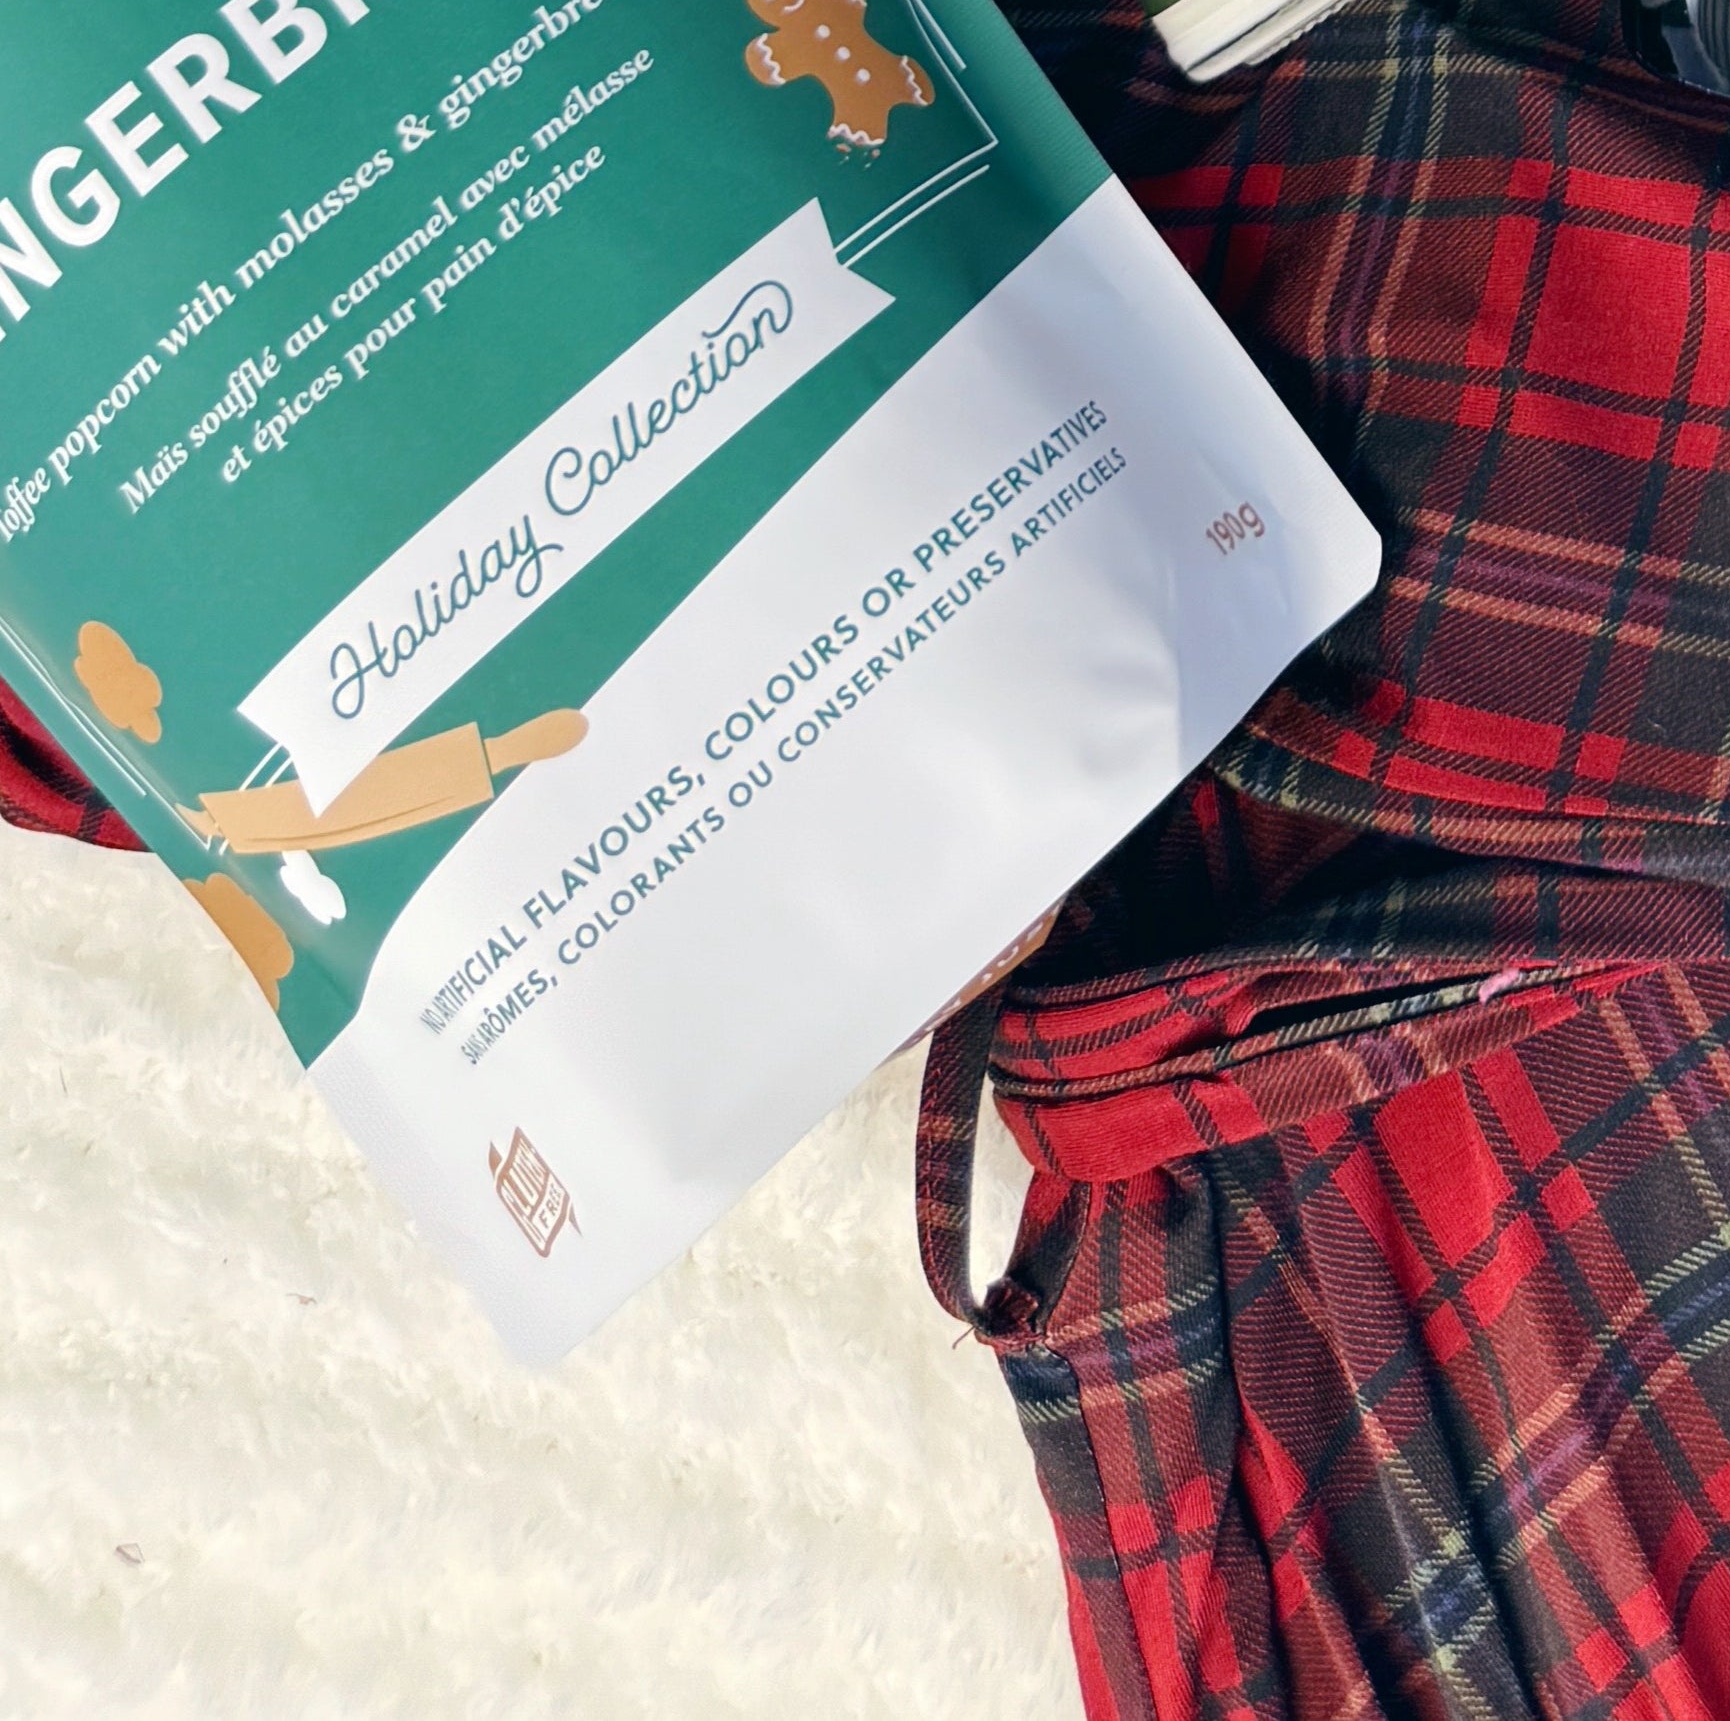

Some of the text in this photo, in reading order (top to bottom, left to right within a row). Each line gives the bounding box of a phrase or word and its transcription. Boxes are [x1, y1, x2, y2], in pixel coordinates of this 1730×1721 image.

[47, 354, 162, 486] popcorn
[157, 279, 237, 357] with
[234, 147, 395, 291] molasses
[394, 113, 437, 154] &
[118, 48, 655, 515] Maïs soufflé au caramel avec mélasse
[221, 144, 606, 485] et épices pour pain d'épice
[329, 280, 793, 720] Holiday Collection
[418, 399, 1108, 1036] NO ARTIFICIAL FLAVOURS, COLOURS OR PRESERVATIVES
[475, 968, 559, 1048] ARÔMES,
[557, 806, 726, 966] COLORANTS
[727, 760, 774, 808] OU
[777, 550, 1007, 763] CONSERVATEURS
[1009, 446, 1128, 558] ARTIFICIELS
[1205, 500, 1266, 556] 190g
